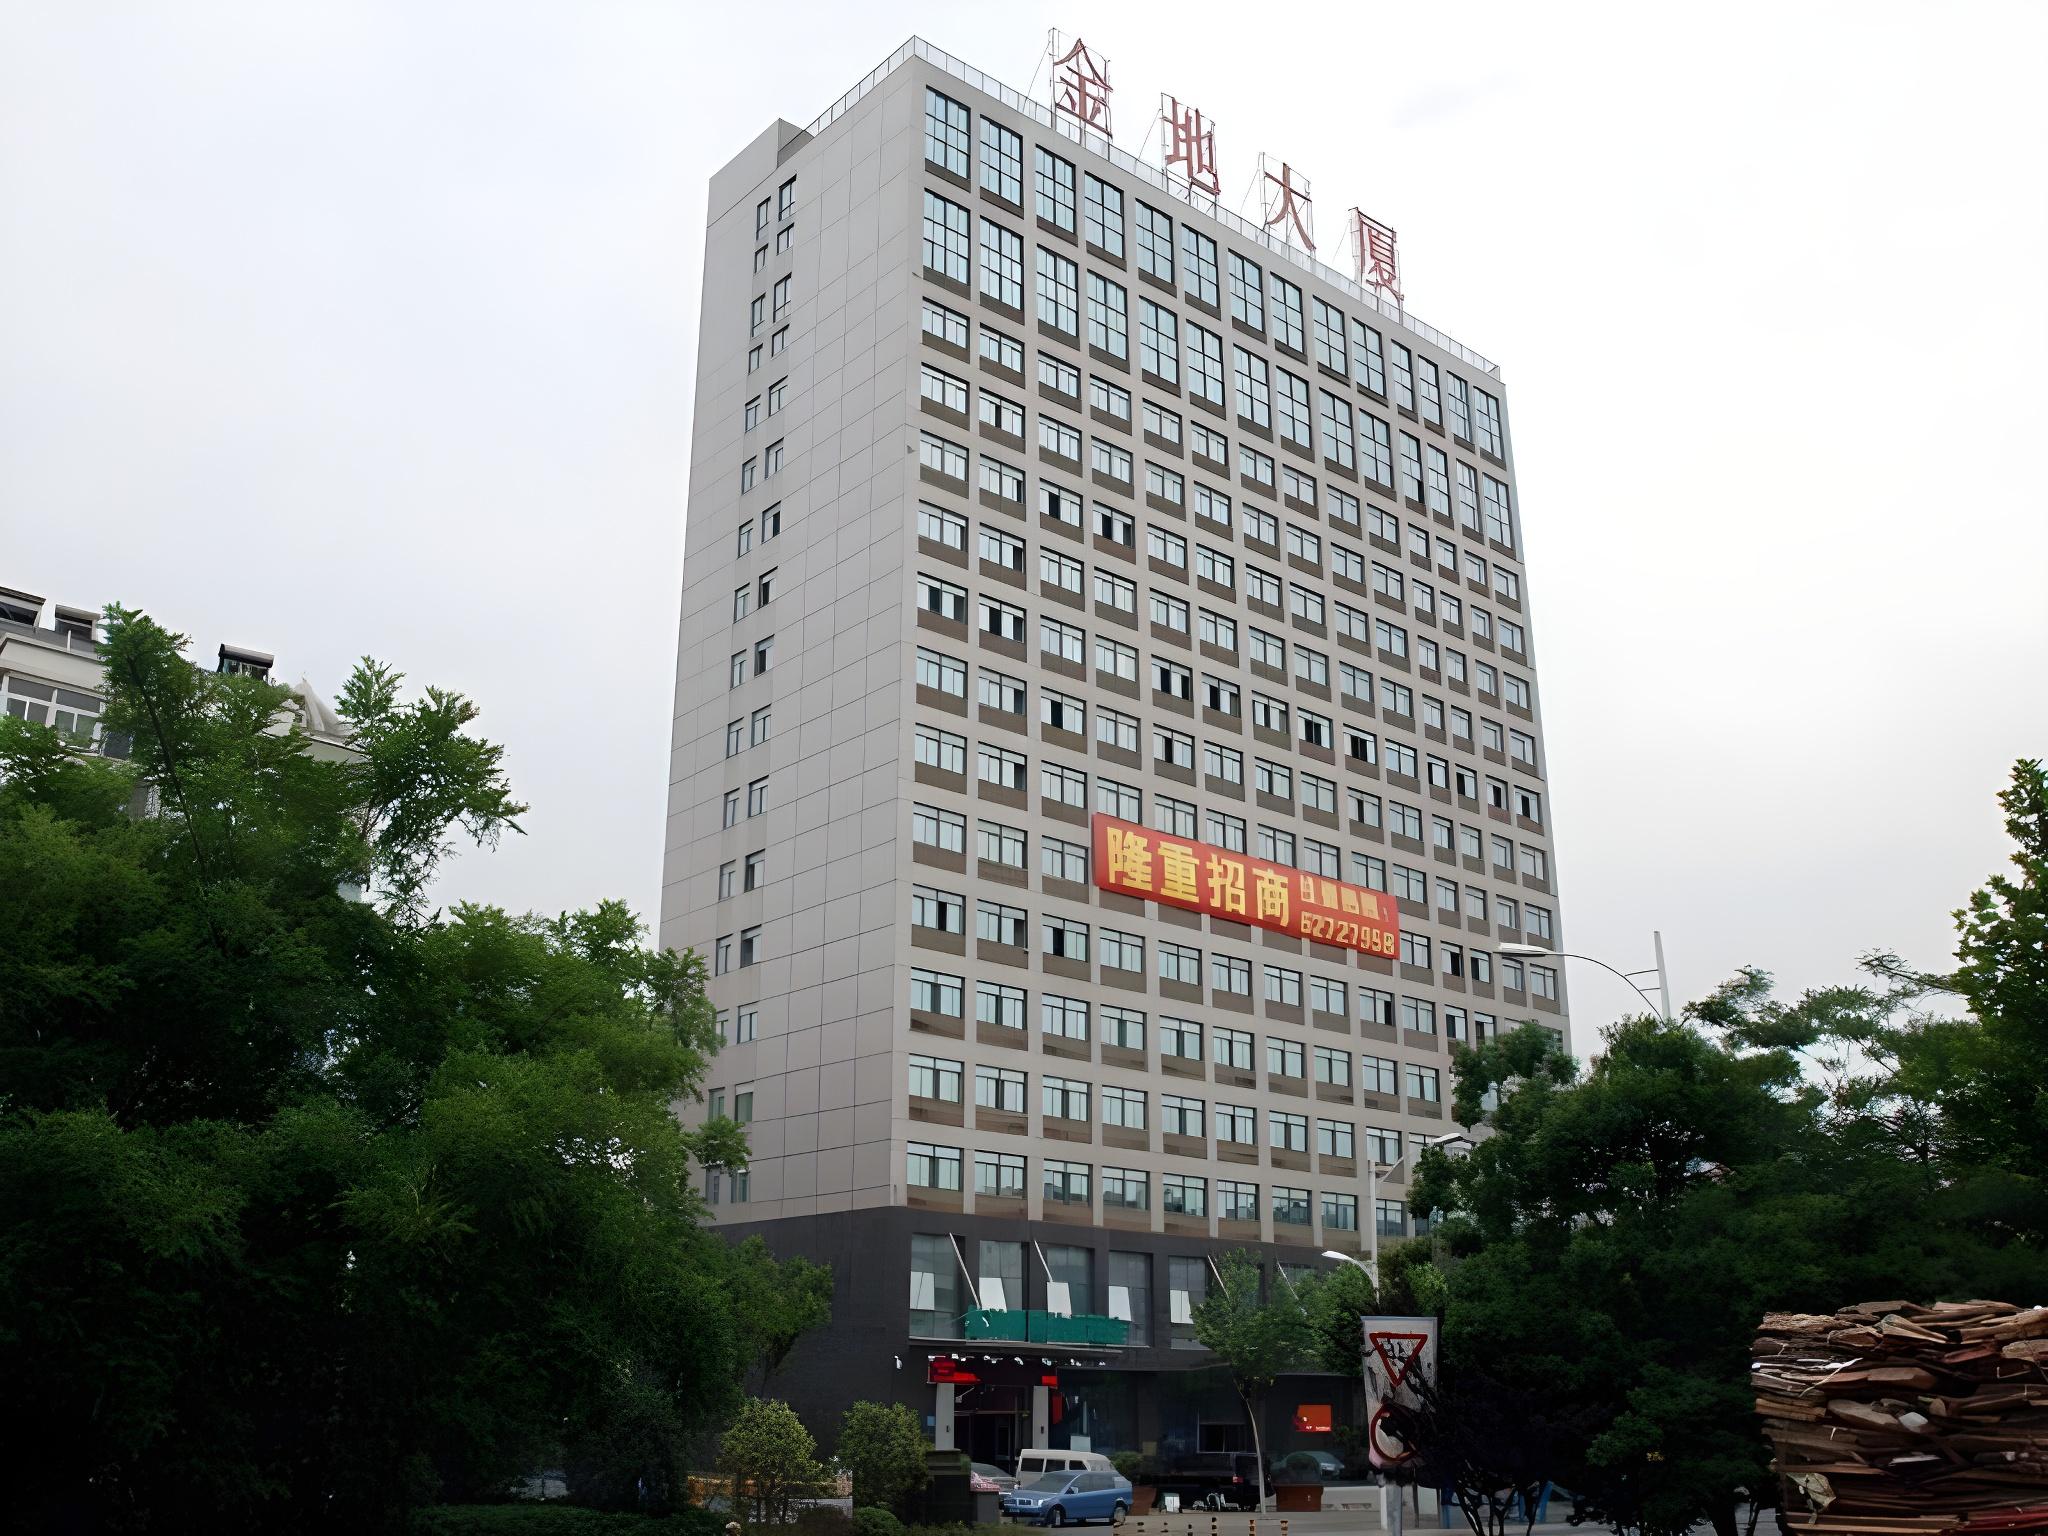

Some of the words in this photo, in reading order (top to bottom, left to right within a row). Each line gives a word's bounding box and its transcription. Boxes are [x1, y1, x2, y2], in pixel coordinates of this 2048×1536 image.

[1053, 38, 1404, 302] 金地大厦
[1107, 826, 1290, 927] 隆重招商
